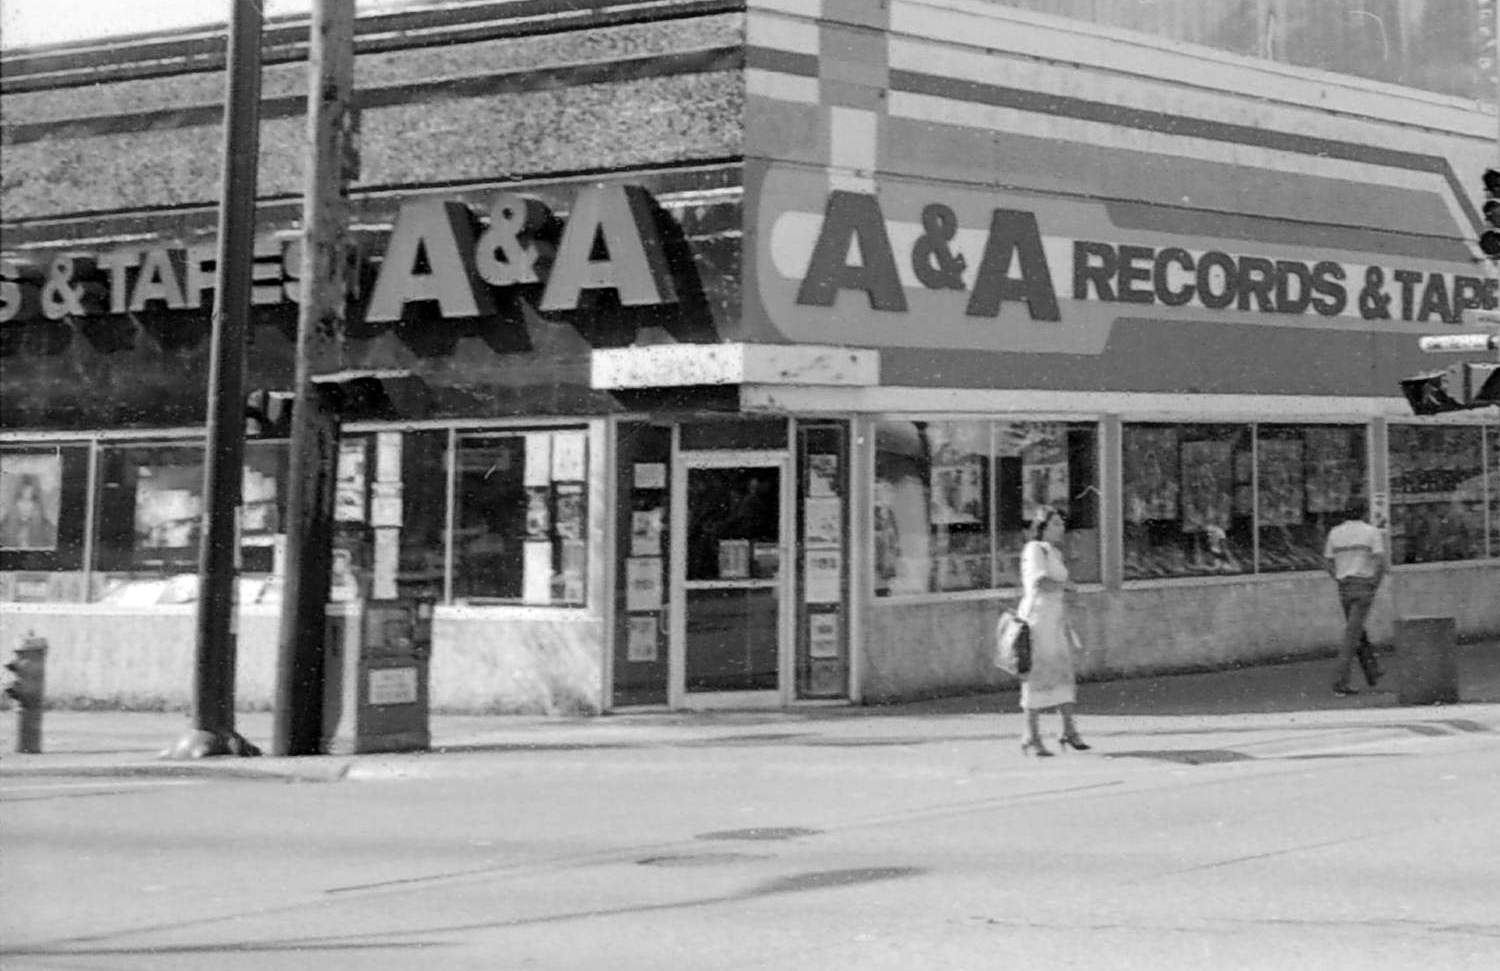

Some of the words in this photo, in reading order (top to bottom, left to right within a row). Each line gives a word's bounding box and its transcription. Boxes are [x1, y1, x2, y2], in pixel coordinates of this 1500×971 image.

[364, 183, 662, 323] A&A
[796, 188, 1062, 322] A&A
[1072, 239, 1348, 317] RECORDS
[1358, 265, 1393, 321] &
